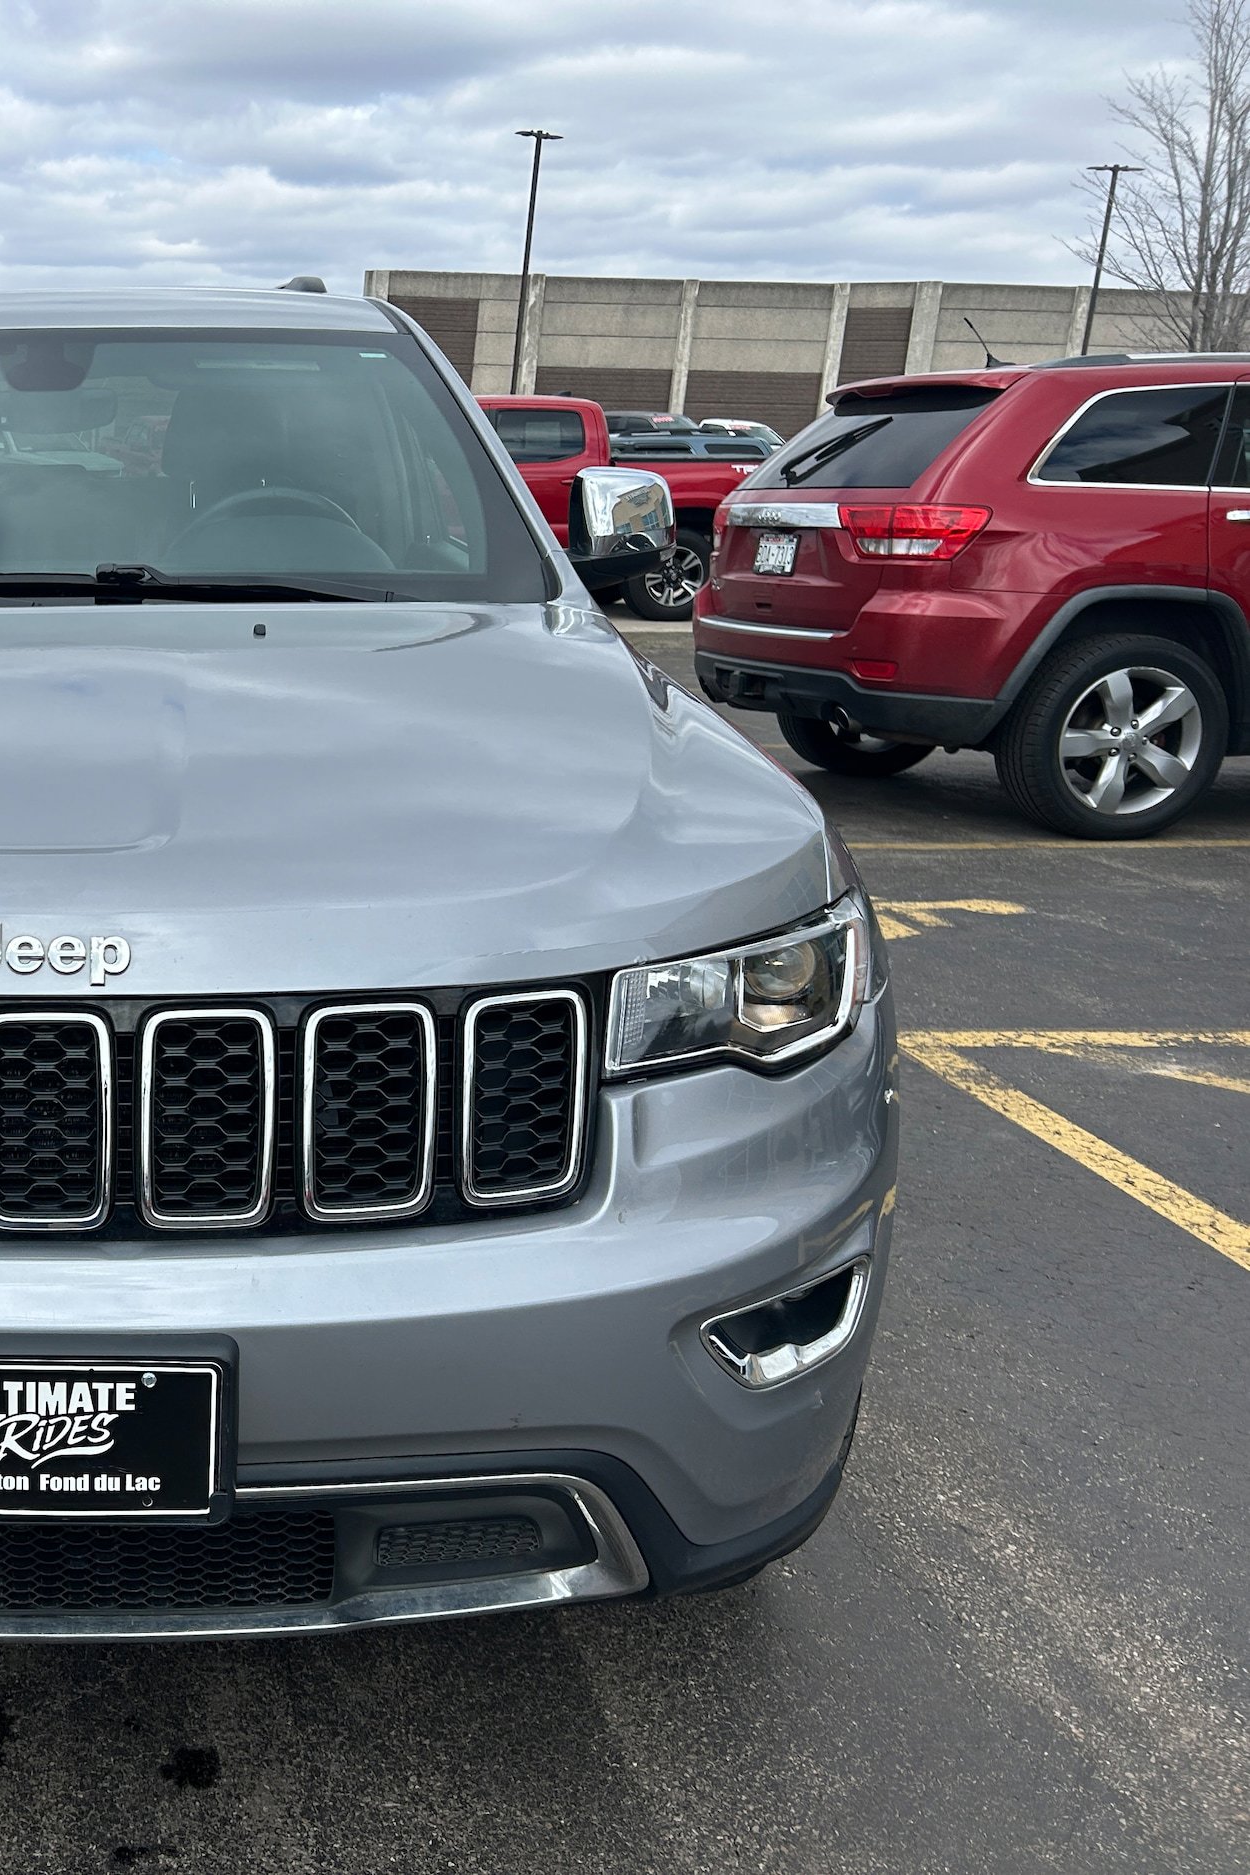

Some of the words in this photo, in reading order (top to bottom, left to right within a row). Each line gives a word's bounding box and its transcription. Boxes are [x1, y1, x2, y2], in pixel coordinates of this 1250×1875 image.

[39, 1472, 90, 1492] Fond
[94, 1473, 121, 1492] du
[125, 1474, 162, 1492] Lac
